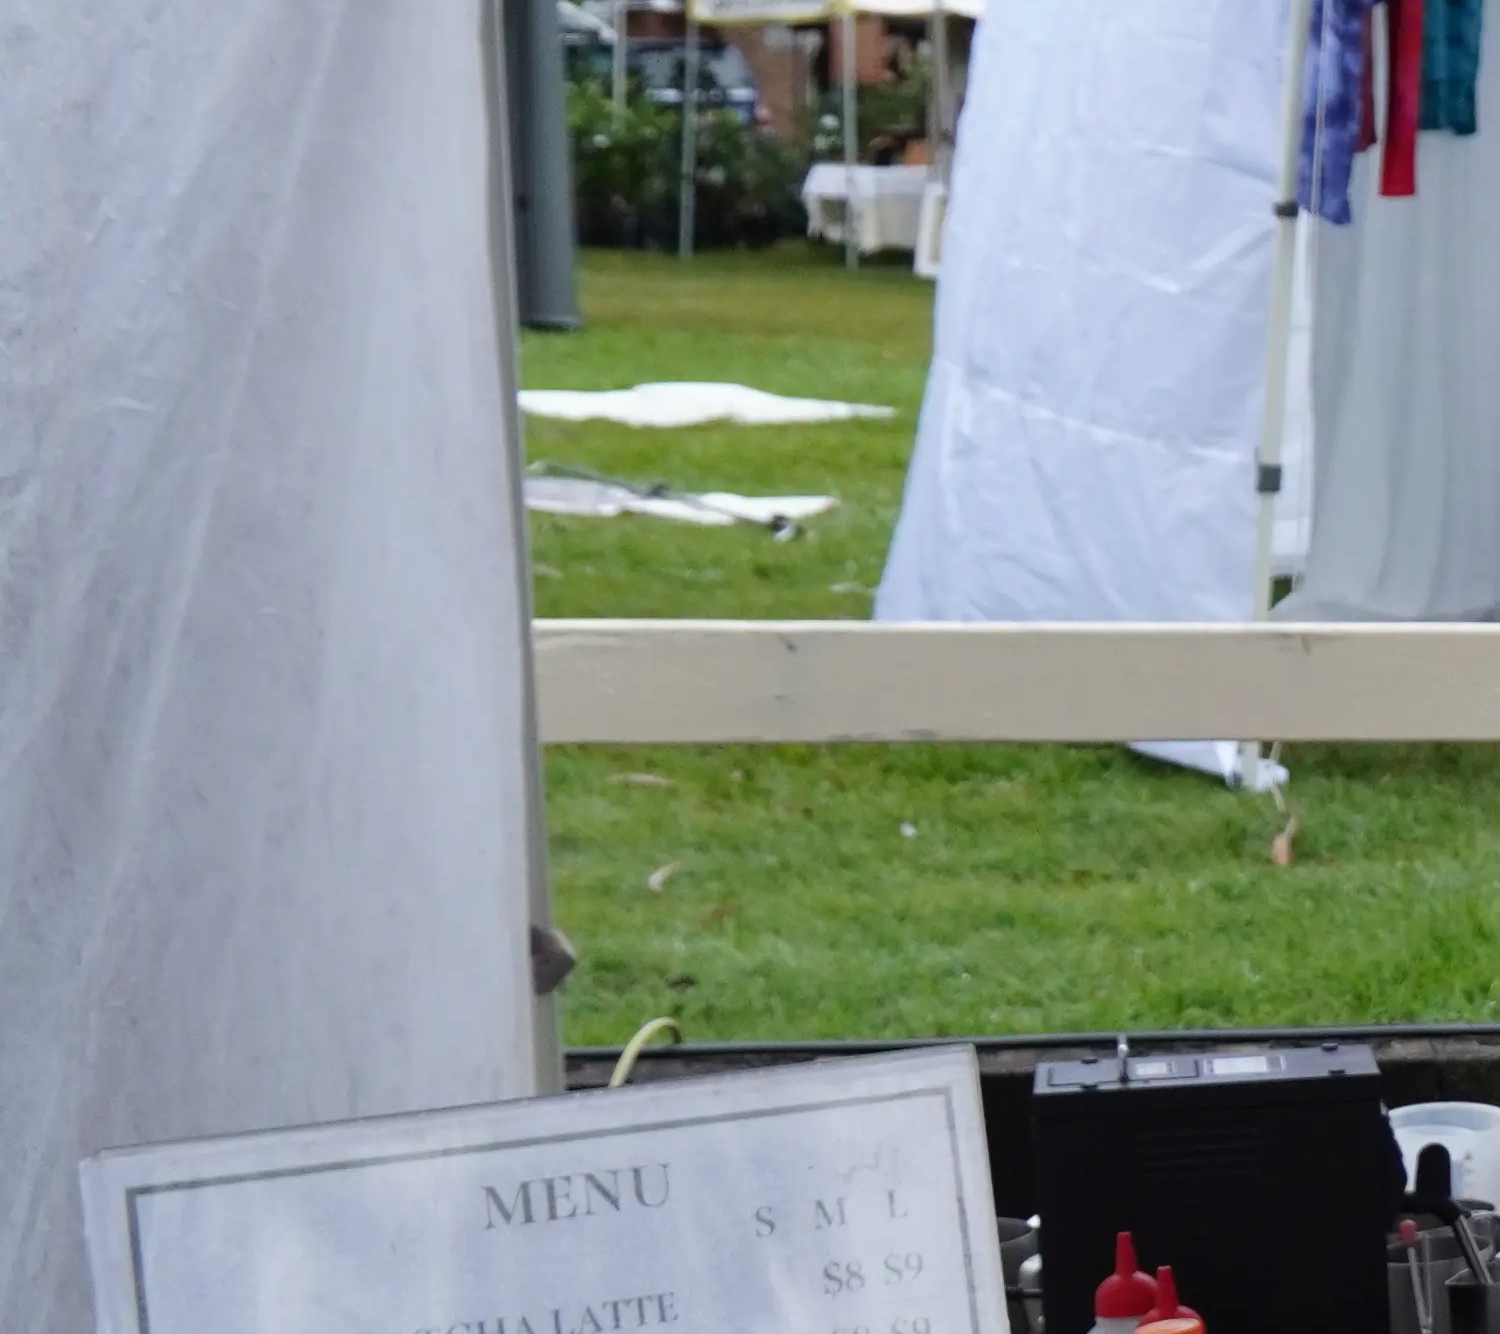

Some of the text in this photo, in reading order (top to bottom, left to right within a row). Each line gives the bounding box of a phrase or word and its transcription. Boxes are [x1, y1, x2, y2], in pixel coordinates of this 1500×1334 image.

[482, 1163, 669, 1230] MENU
[753, 1188, 909, 1238] S M L
[821, 1259, 866, 1298] $8
[882, 1252, 924, 1285] $9
